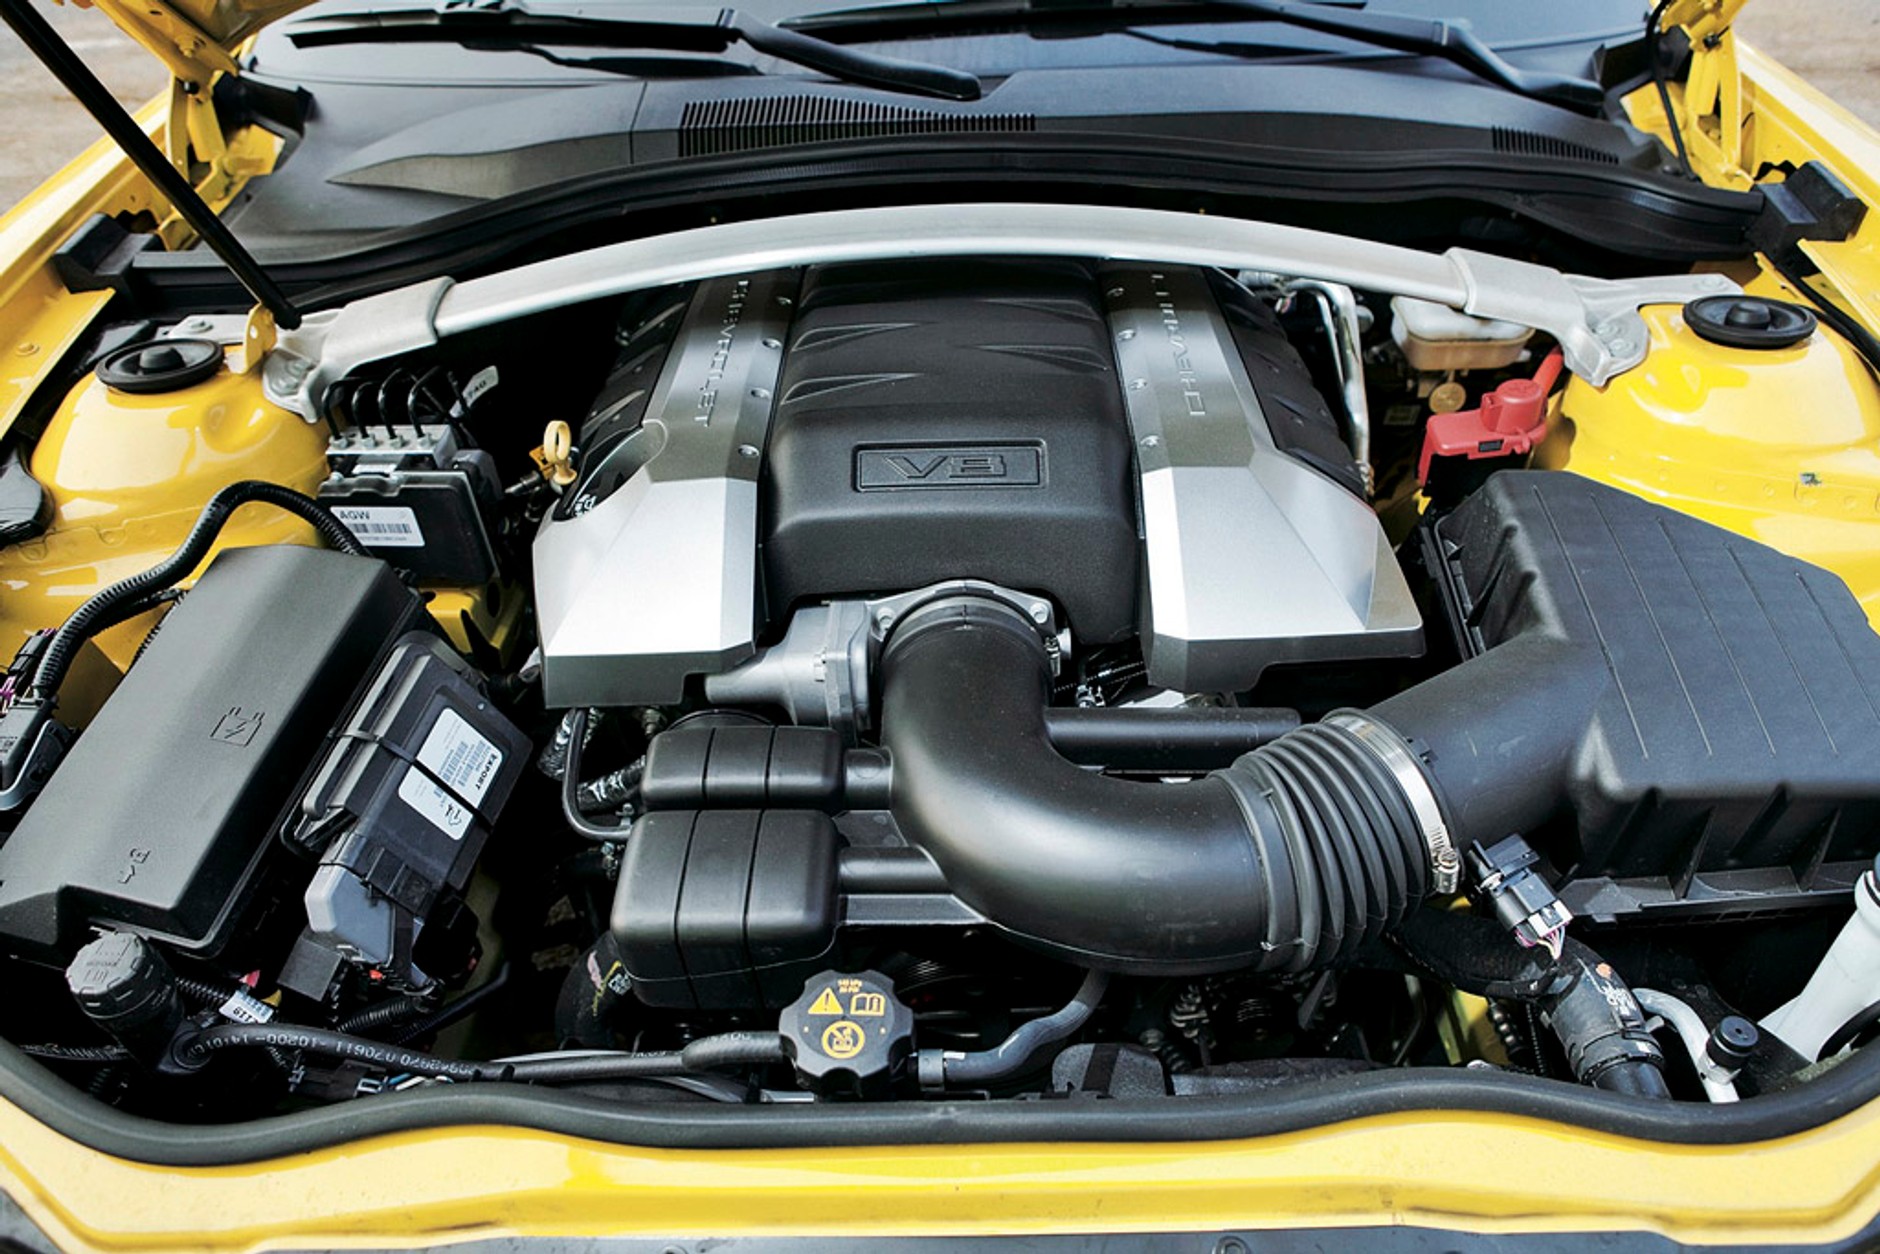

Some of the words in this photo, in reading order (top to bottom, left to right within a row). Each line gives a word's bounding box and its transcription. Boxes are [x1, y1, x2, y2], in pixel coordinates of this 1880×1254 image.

[883, 455, 1007, 479] V8
[340, 509, 371, 520] AGW
[474, 752, 499, 791] EXPORT
